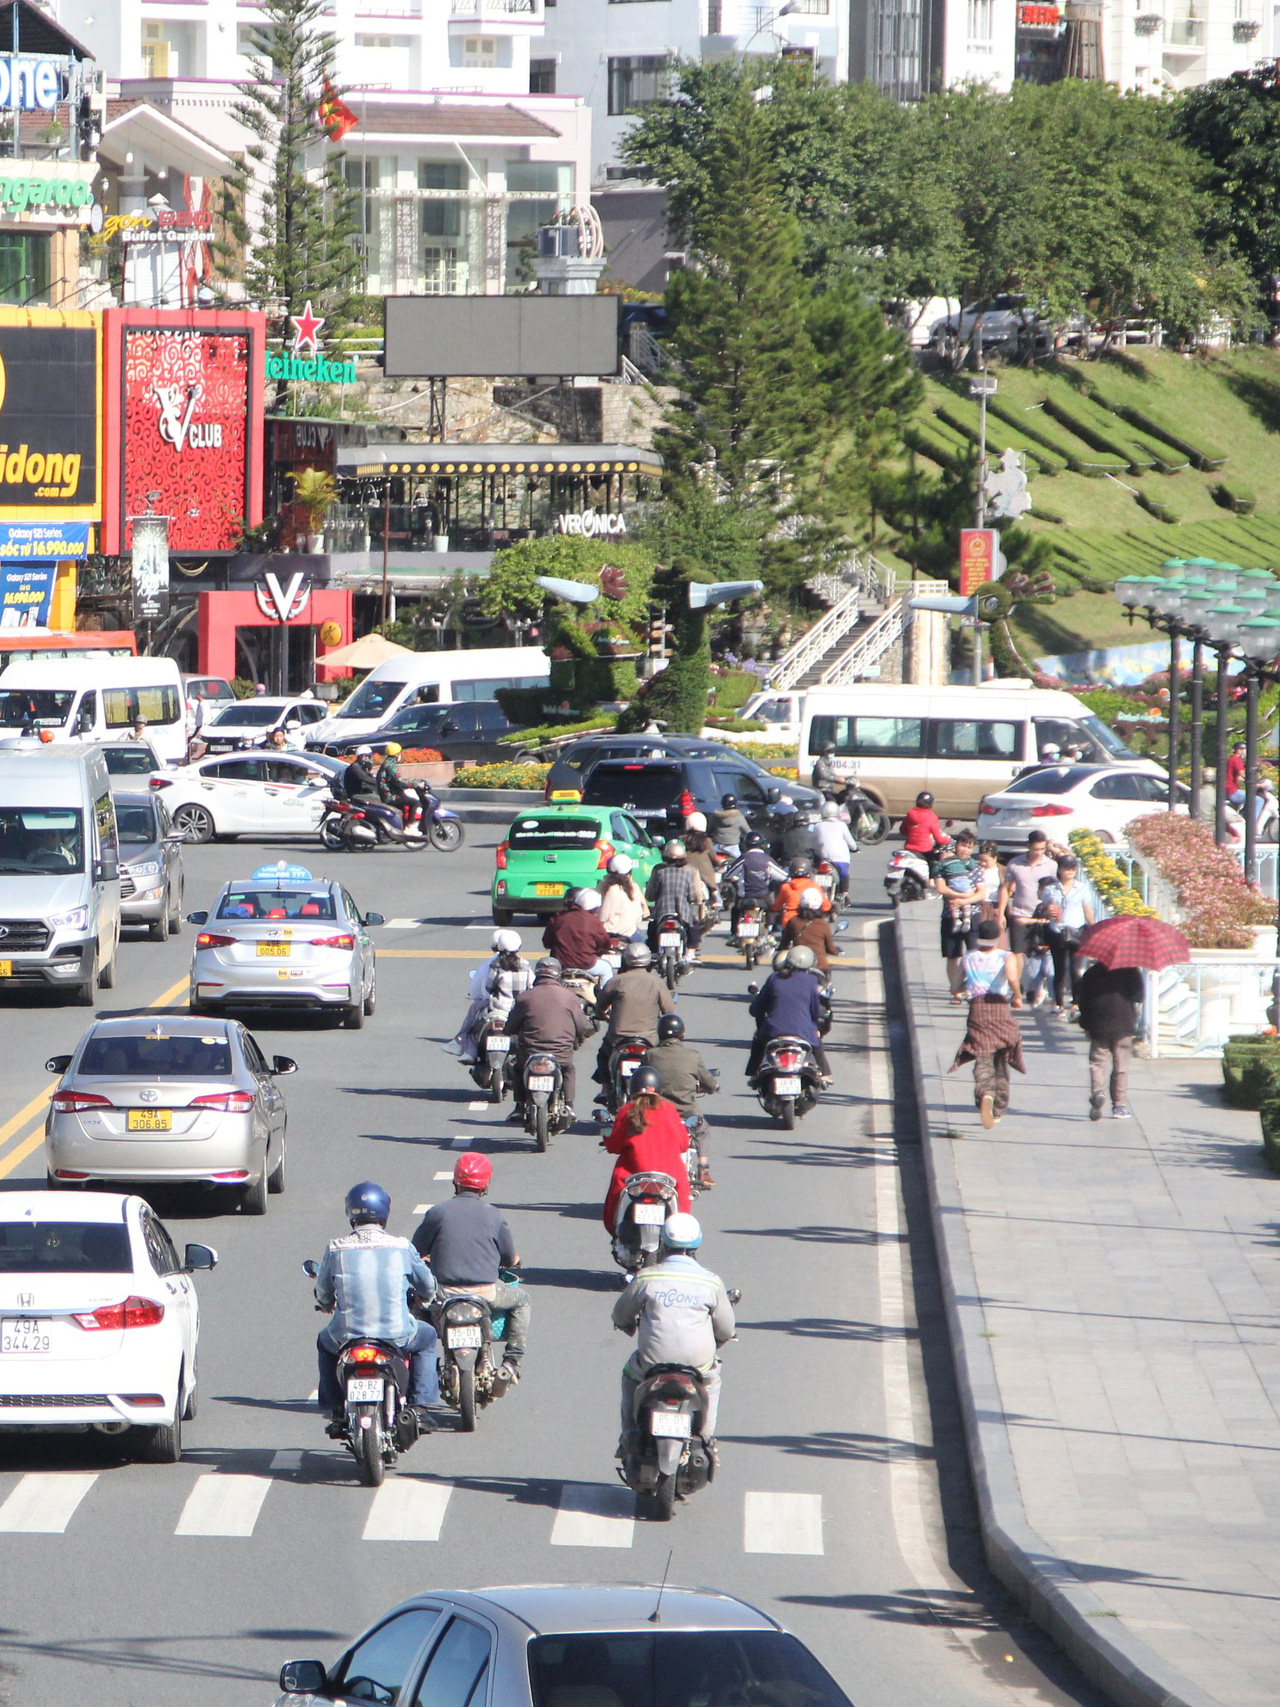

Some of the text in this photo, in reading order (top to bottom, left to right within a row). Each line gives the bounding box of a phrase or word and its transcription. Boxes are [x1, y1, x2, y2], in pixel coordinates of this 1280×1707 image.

[159, 210, 213, 231] BBQ
[122, 231, 216, 241] Buffet Garden
[189, 423, 222, 448] CLUB
[559, 509, 626, 537] VERONICA
[260, 948, 286, 956] 005.06
[141, 1110, 159, 1119] 49A
[133, 1120, 167, 1129] 306.85
[14, 1320, 40, 1335] 49A
[4, 1336, 51, 1350] 344.29
